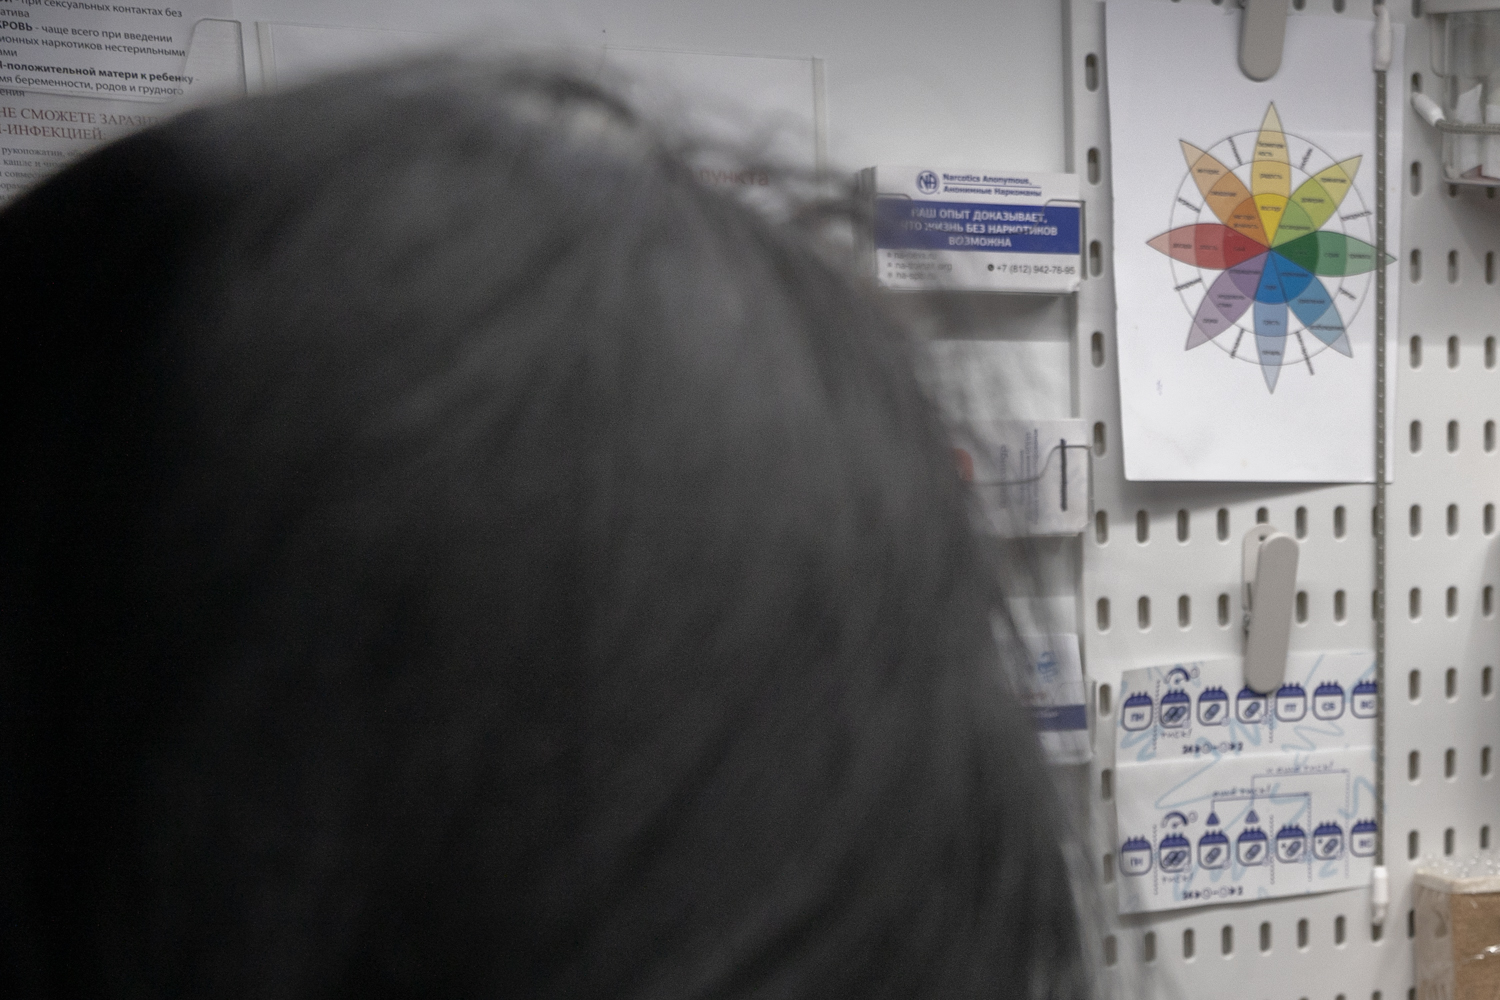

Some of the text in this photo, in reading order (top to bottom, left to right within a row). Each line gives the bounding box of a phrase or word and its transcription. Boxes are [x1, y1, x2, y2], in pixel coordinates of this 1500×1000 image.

[44, 0, 111, 11] сексуальных
[113, 5, 163, 16] контактах
[165, 9, 183, 18] без
[42, 26, 69, 35] чаще
[71, 29, 100, 37] всего
[102, 31, 122, 40] при
[124, 33, 173, 43] введении
[41, 39, 103, 51] наркотиков
[104, 44, 186, 57] нестерильными
[98, 70, 138, 81] матери
[149, 74, 194, 85] ребенку
[15, 75, 94, 90] беременности,
[95, 82, 127, 93] родов
[138, 86, 184, 97] грудного
[20, 107, 97, 124] СМОЖЕТЕ
[943, 174, 981, 183] Narcotics
[944, 187, 1042, 197] Анонимные Наркоманы
[939, 210, 970, 219] ОПЫТ
[973, 210, 1047, 223] ДОКАЗЫВАЕТ,
[966, 223, 985, 233] БЕЗ
[988, 225, 1058, 236] НАРКОТИКОВ
[949, 236, 1012, 247] ВОЗМОЖНА
[1009, 265, 1031, 276] (812)
